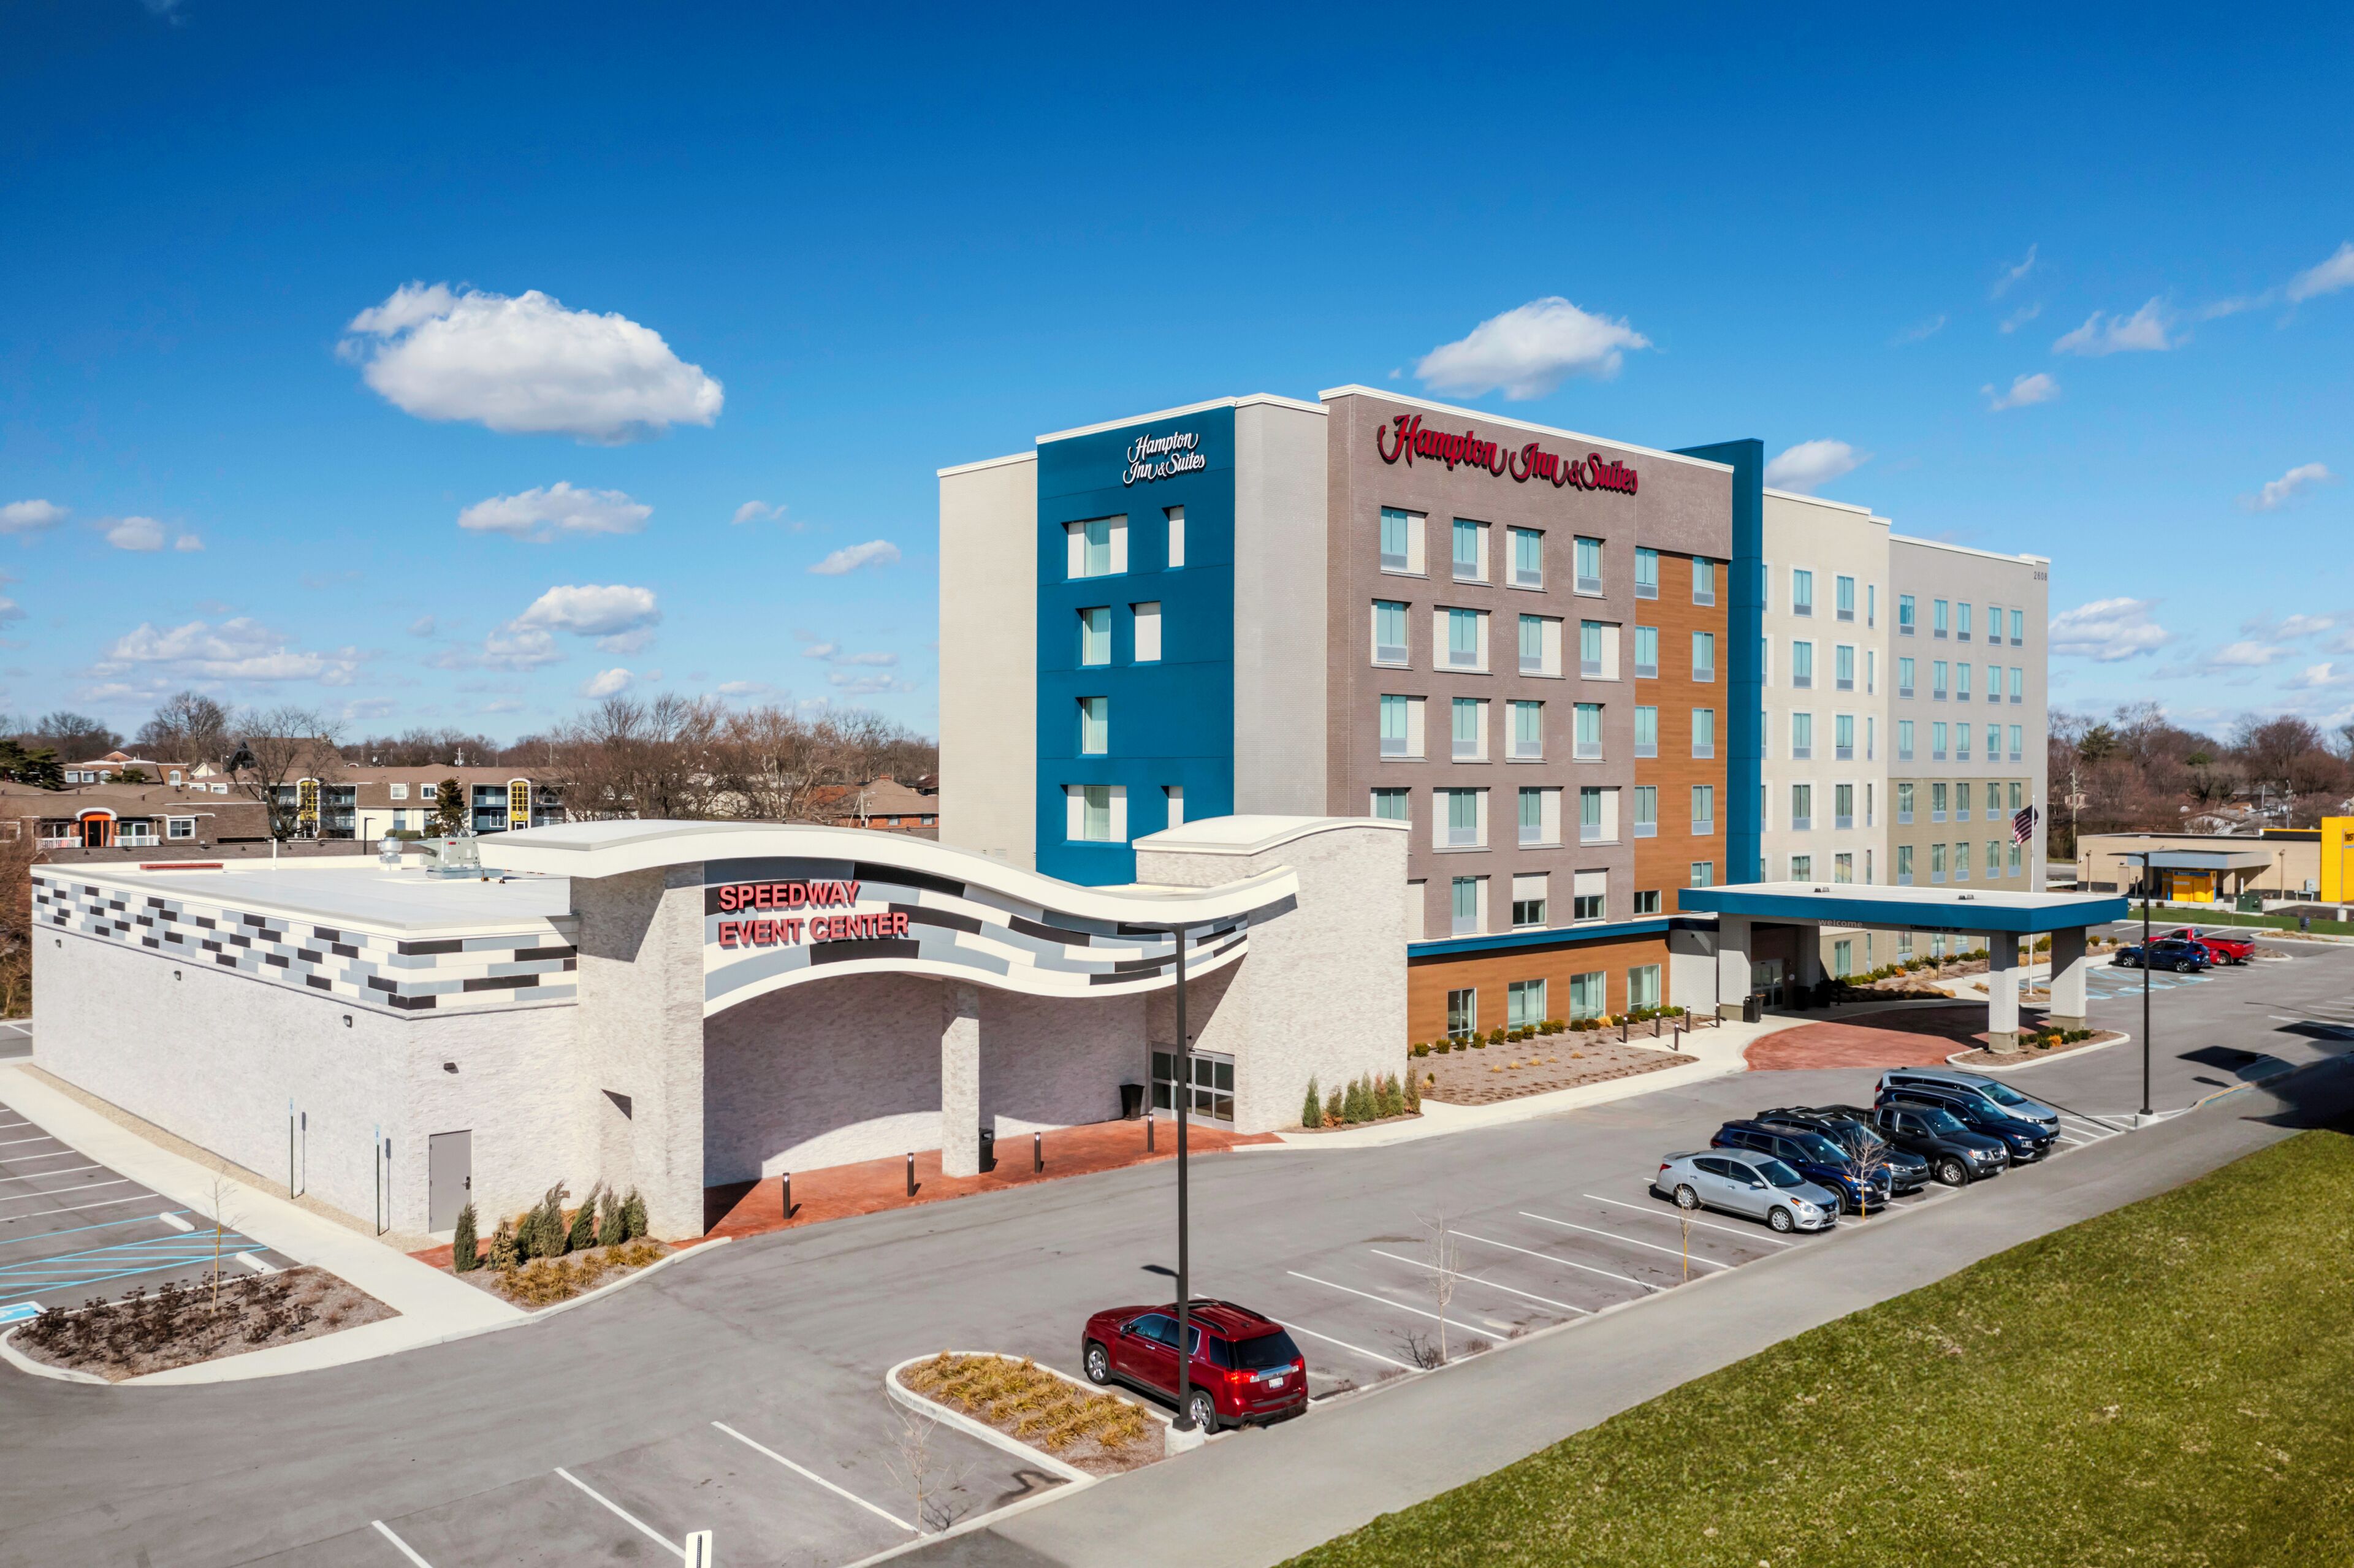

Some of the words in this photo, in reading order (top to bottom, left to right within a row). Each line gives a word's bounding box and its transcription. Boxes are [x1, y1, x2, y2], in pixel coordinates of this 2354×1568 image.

[1127, 431, 1199, 463] Hampton
[1377, 414, 1507, 477] Hampton
[1509, 443, 1568, 488] Inn
[1580, 452, 1639, 495] Suites
[1122, 460, 1159, 484] Inn
[1165, 451, 1206, 474] Suites
[718, 880, 861, 911] SPEEDWAY
[718, 917, 804, 946] EVENT
[809, 911, 909, 942] CENTER
[1818, 919, 1864, 928] welcome
